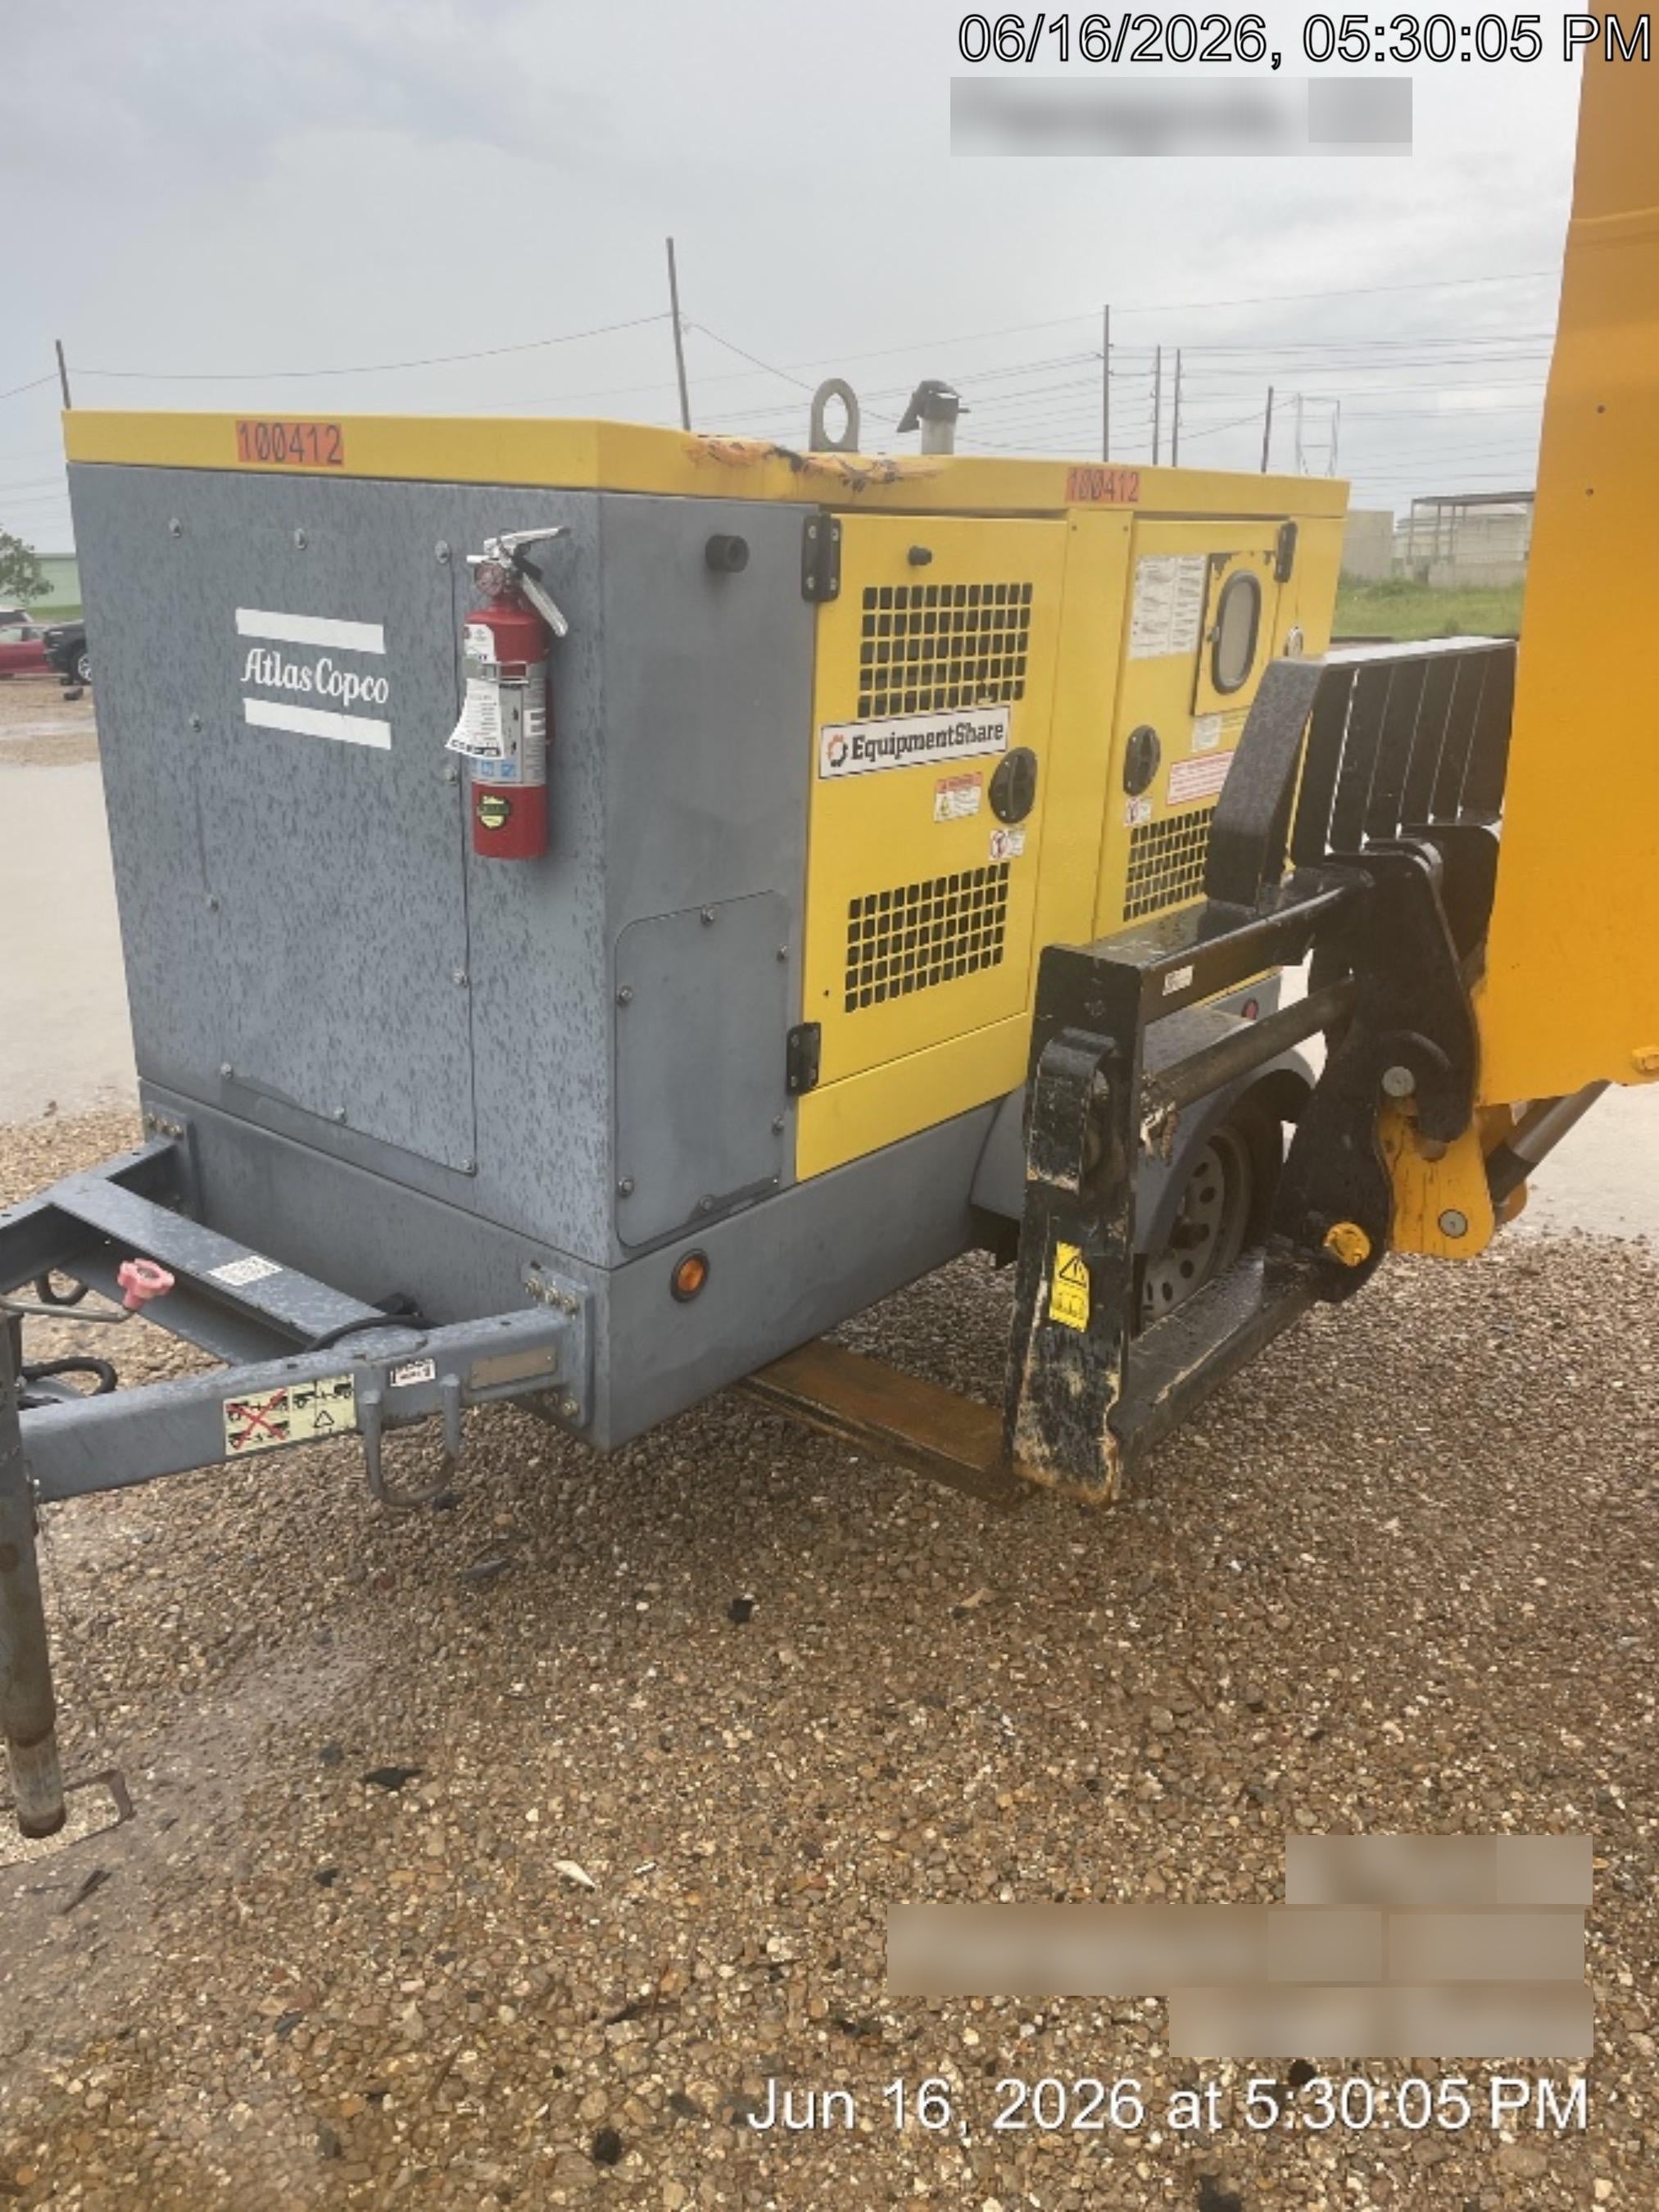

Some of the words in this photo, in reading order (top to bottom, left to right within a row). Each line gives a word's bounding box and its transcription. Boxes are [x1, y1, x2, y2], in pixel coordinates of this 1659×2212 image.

[240, 422, 342, 465] 100412
[1068, 470, 1137, 501] 100412
[240, 647, 312, 691] Atlas
[315, 657, 389, 707] Copco
[852, 723, 1004, 762] EquipmentShare
